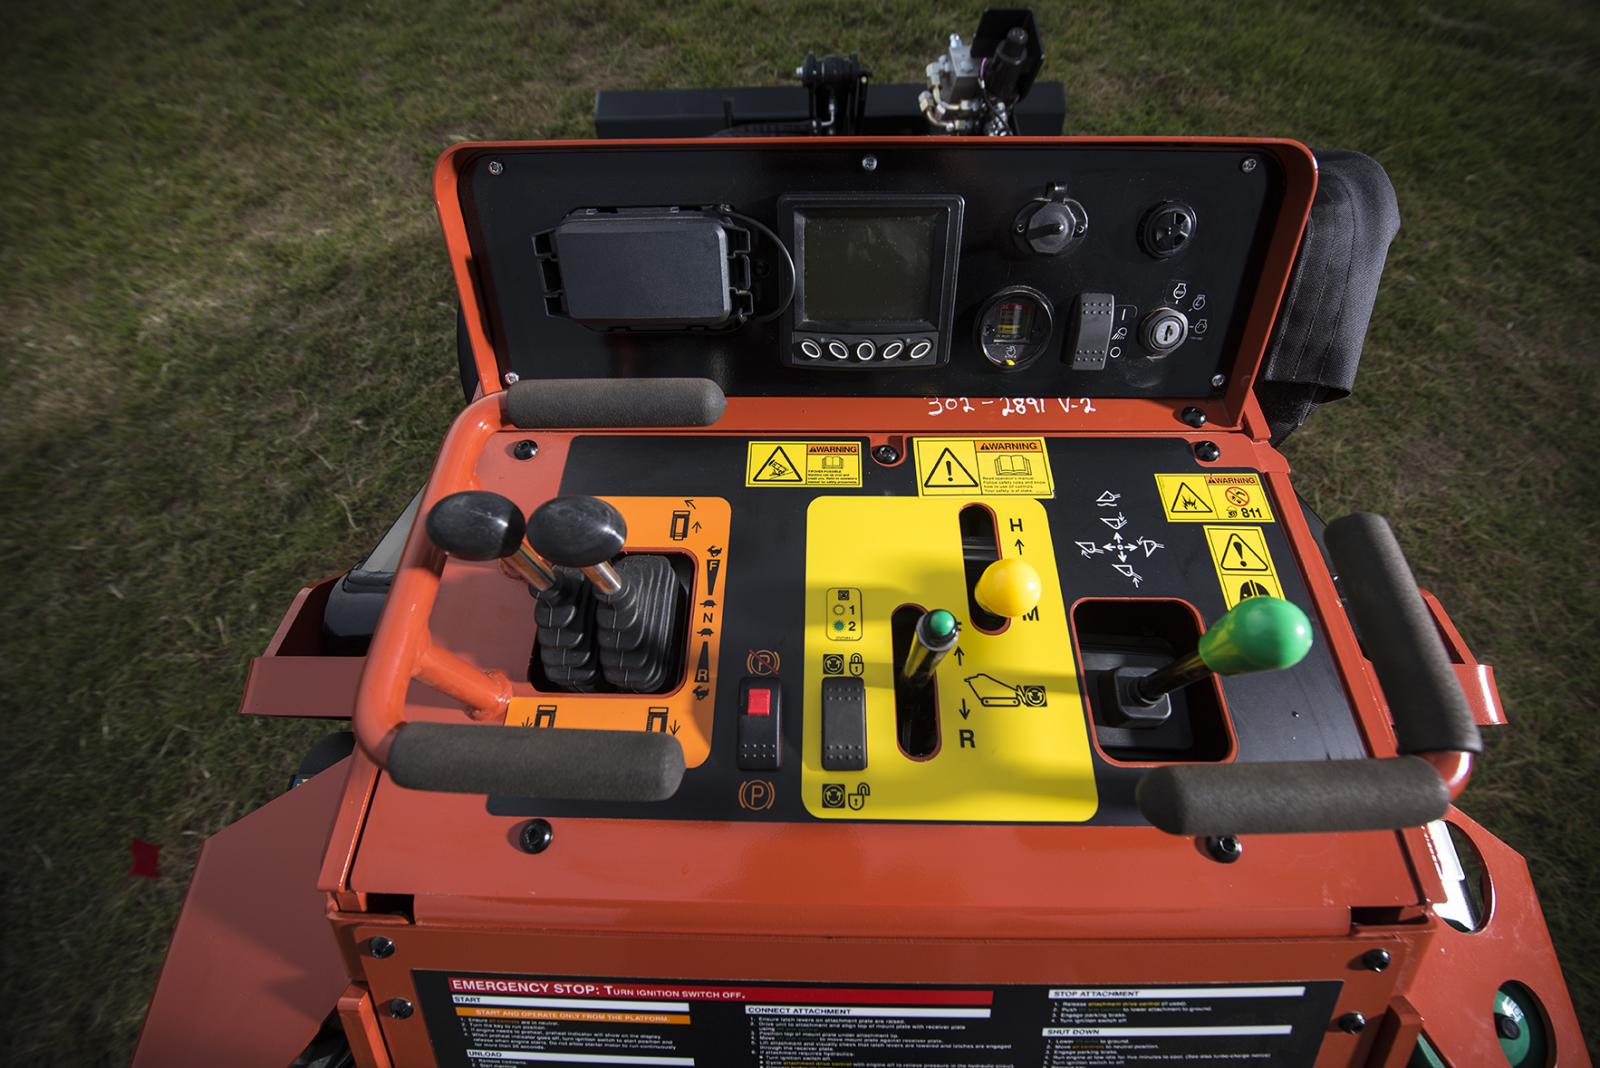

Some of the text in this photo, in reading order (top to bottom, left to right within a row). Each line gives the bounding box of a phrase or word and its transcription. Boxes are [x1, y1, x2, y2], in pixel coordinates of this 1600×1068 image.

[928, 396, 975, 416] 302
[1001, 397, 1045, 416] 2891
[1058, 397, 1096, 414] V-2
[989, 442, 1037, 450] WARNING
[1241, 507, 1262, 518] 811
[1010, 518, 1023, 532] H
[709, 560, 718, 572] F
[850, 605, 856, 615] 1
[703, 612, 713, 623] N
[848, 621, 856, 631] 2
[697, 670, 708, 681] R
[959, 730, 976, 748] R
[453, 980, 746, 999] EMERGENCY STOP: TURN IGNITION SWITCH OFF.
